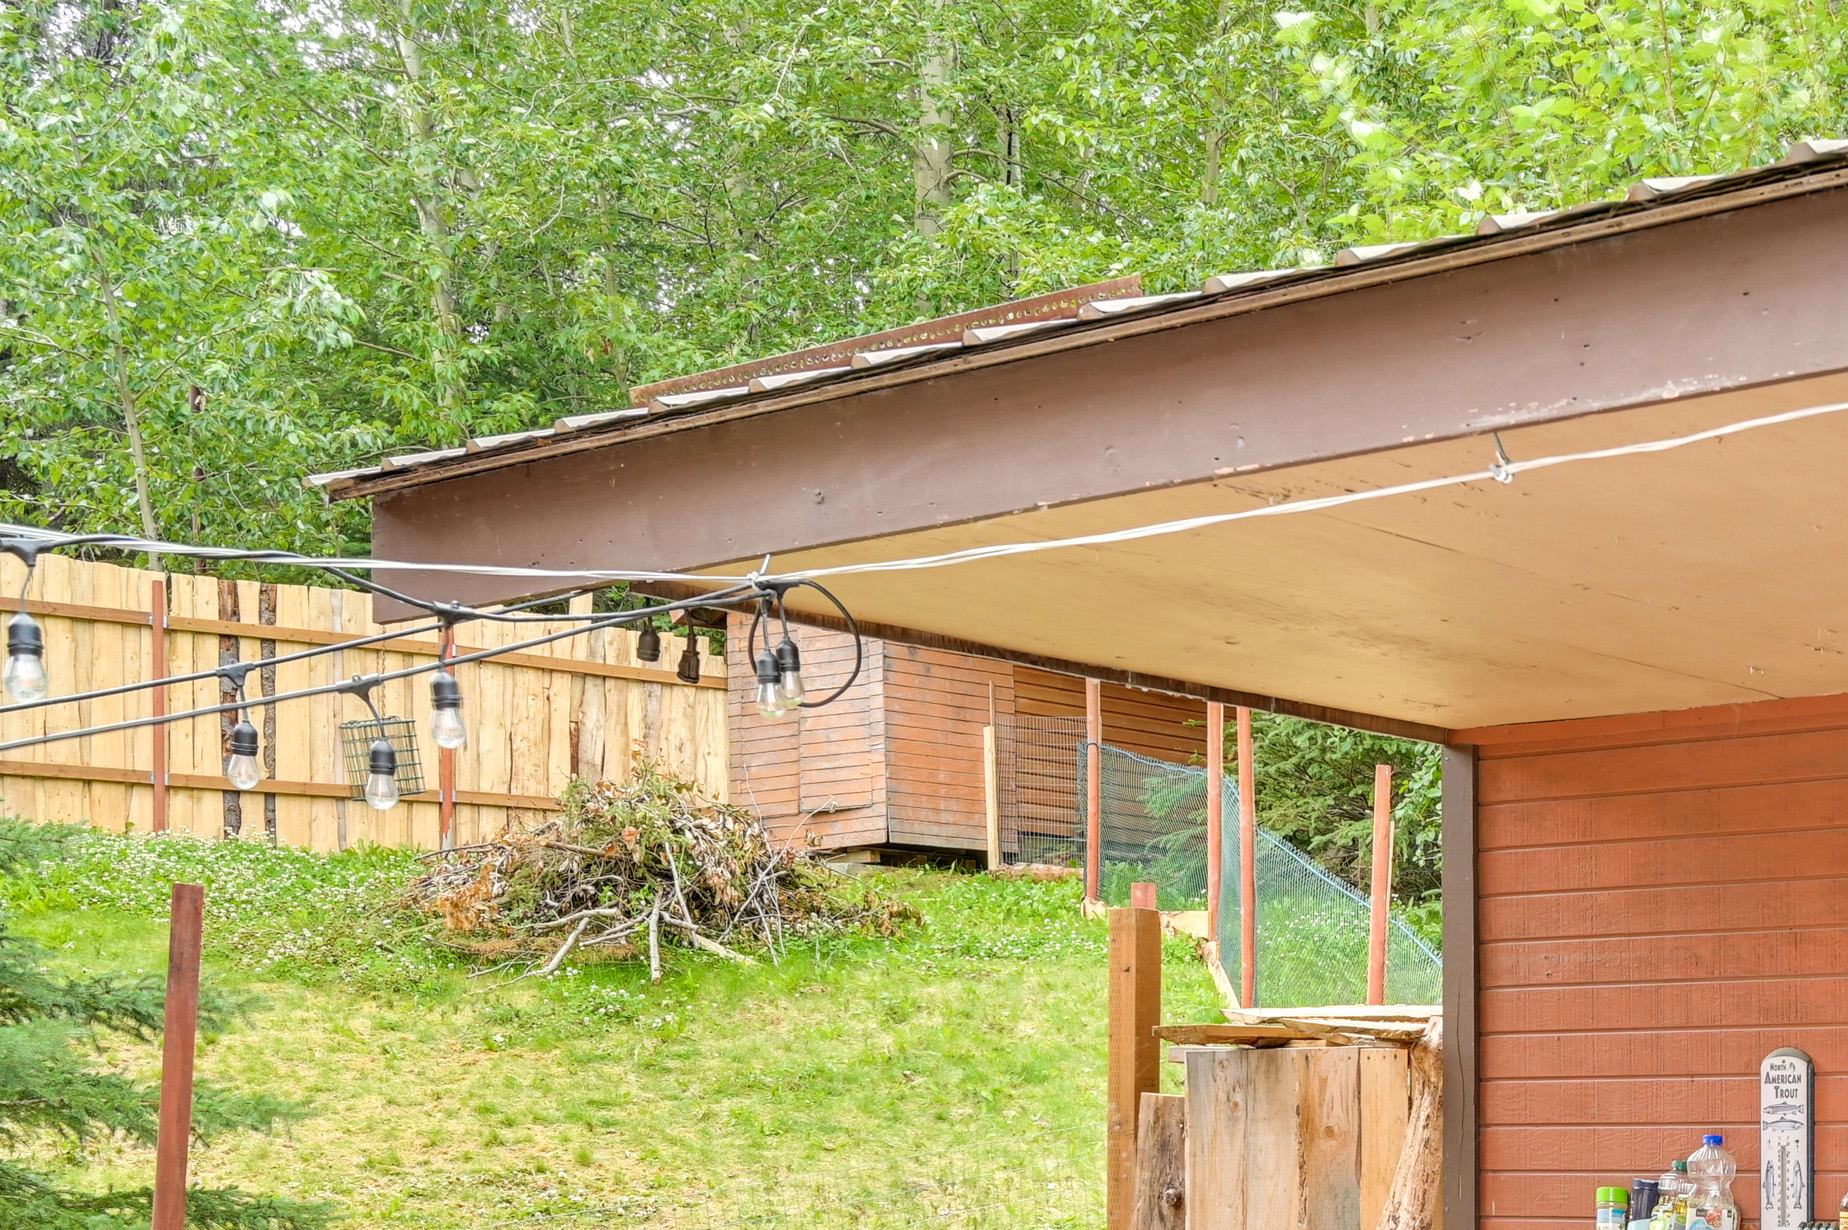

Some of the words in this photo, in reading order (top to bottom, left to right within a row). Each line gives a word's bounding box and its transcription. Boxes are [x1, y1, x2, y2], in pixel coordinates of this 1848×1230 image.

[1770, 1063, 1786, 1071] NORTH
[1764, 1072, 1802, 1084] AMERICAN
[1774, 1086, 1798, 1099] TROUT
